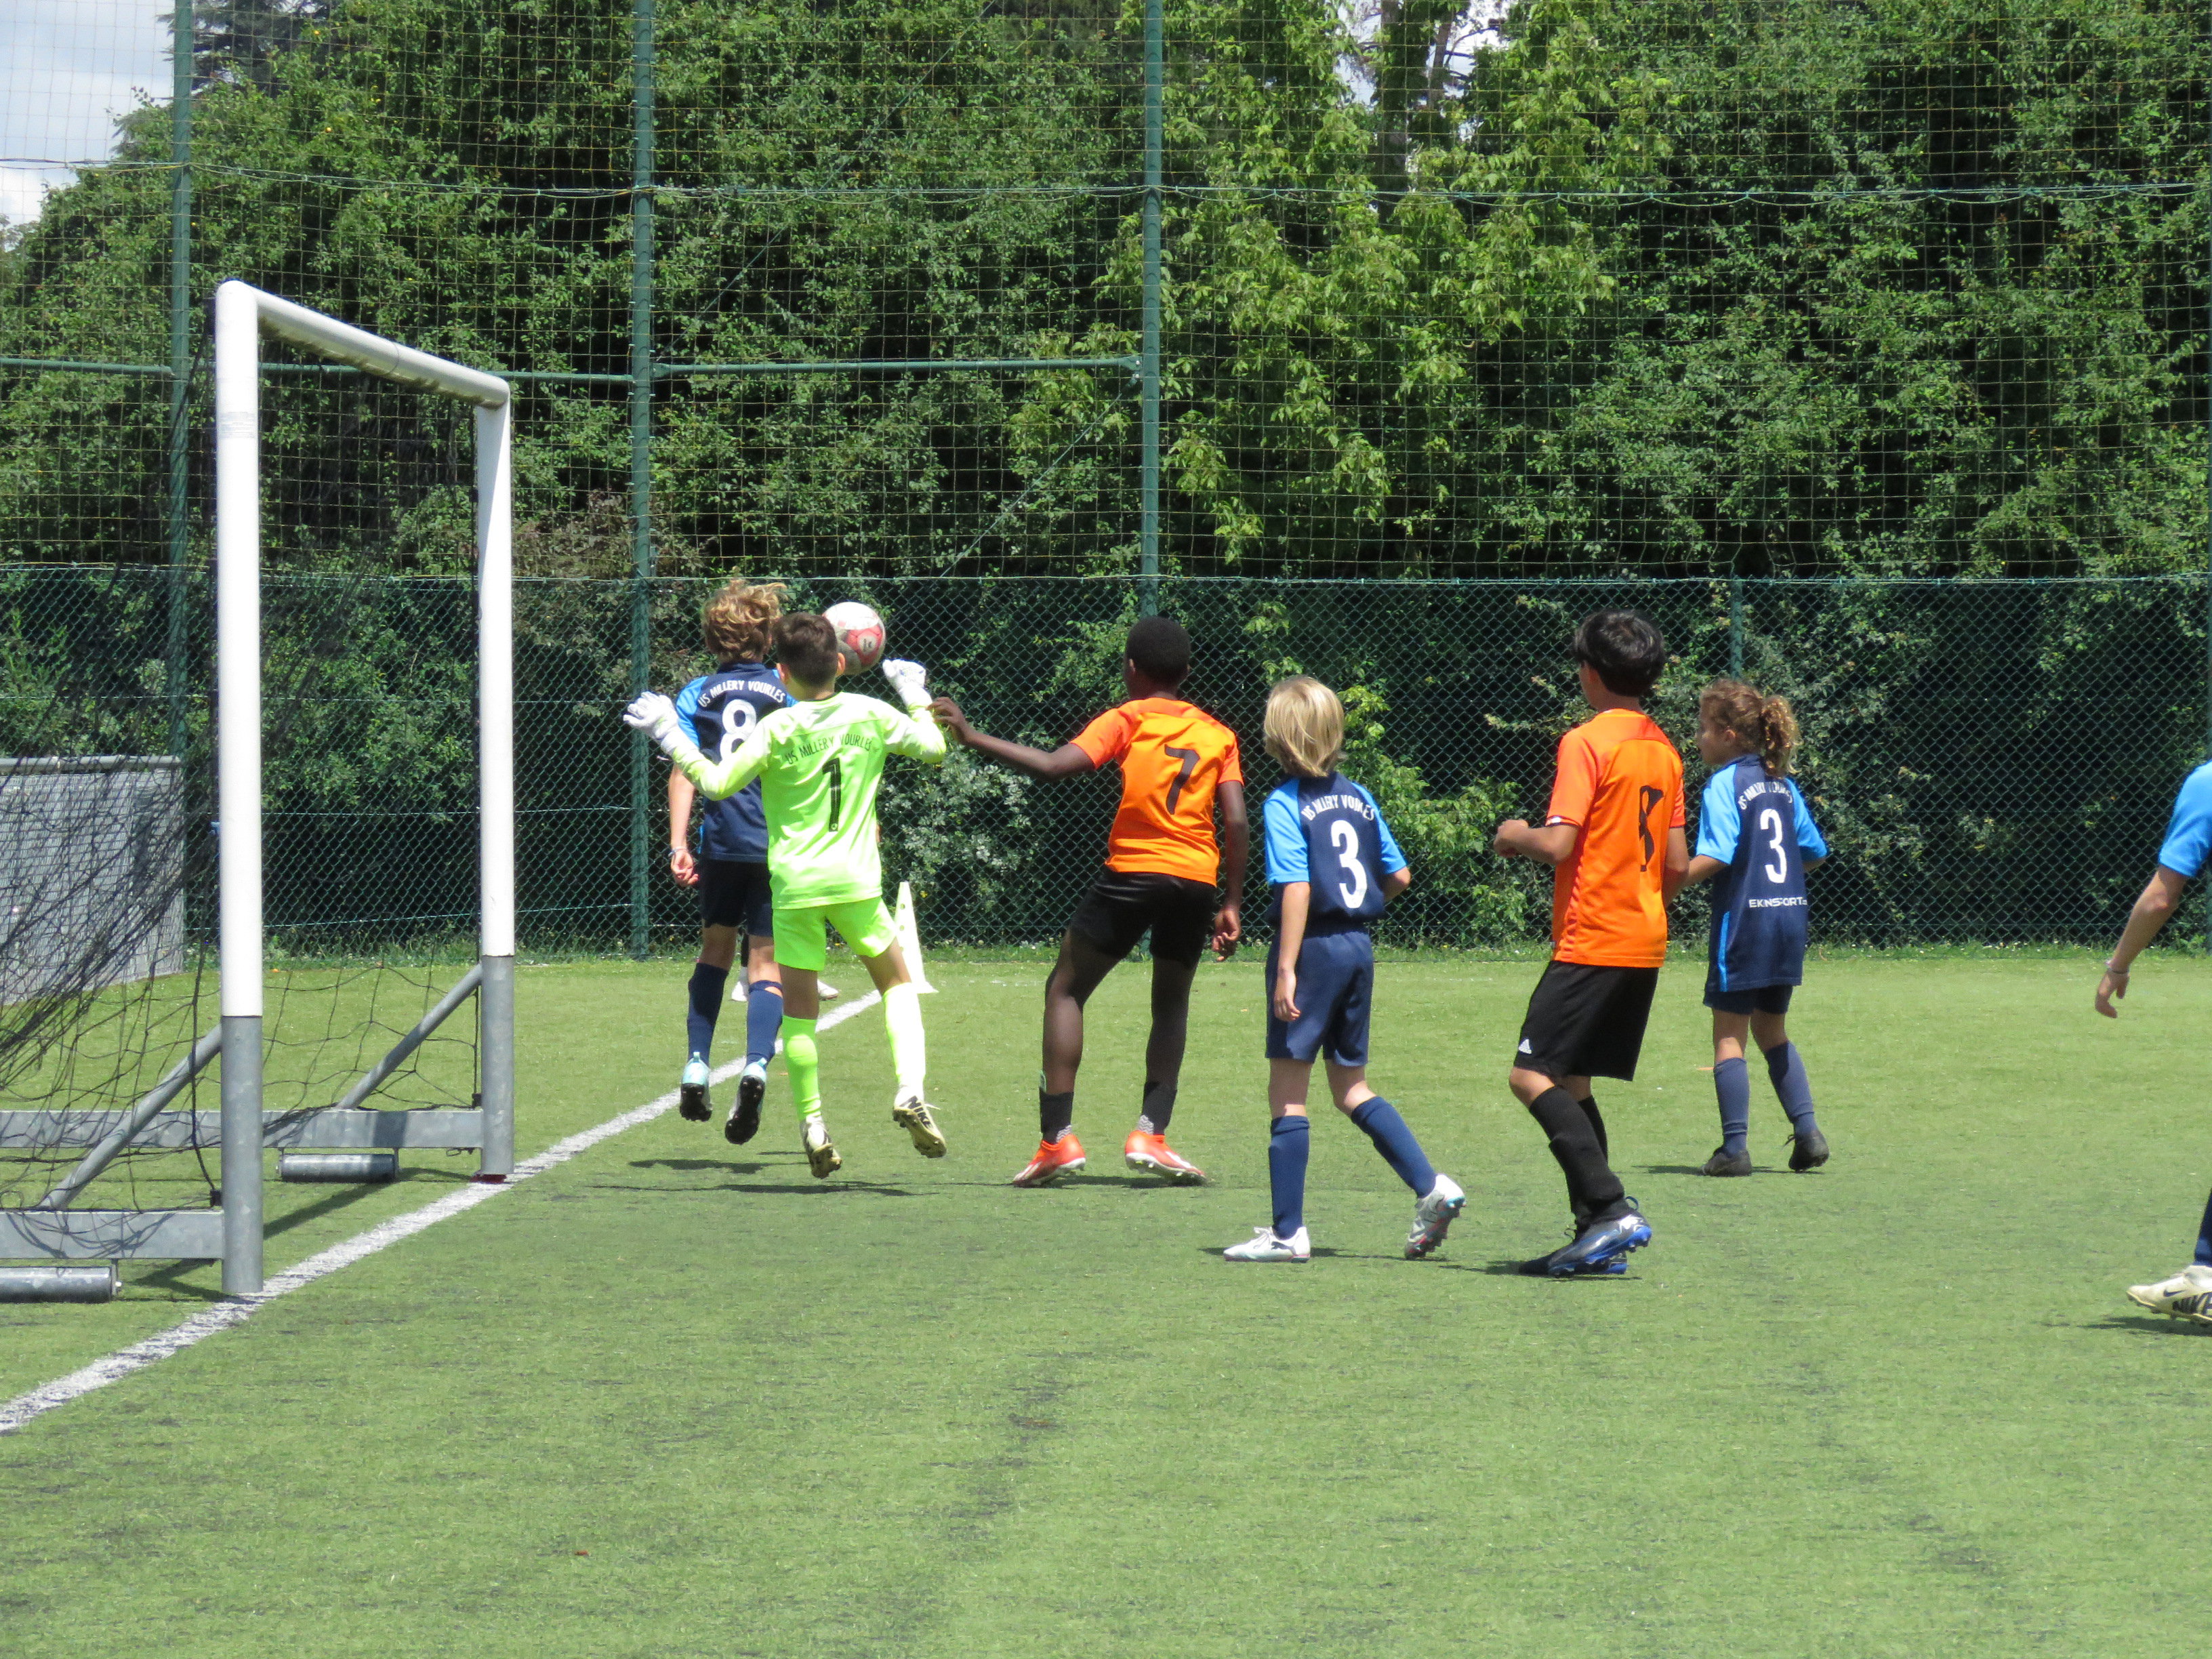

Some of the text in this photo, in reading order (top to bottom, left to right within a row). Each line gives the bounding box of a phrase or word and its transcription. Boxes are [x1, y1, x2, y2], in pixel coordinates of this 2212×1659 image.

[697, 680, 786, 708] US MILLERY VOURLES
[720, 699, 757, 761] 8
[785, 733, 872, 765] US MILLERY VOURLES
[821, 757, 842, 832] 1
[1164, 744, 1201, 815] 7
[1330, 819, 1368, 909] 3
[1760, 808, 1787, 884] 3
[899, 1094, 933, 1129] NIKE
